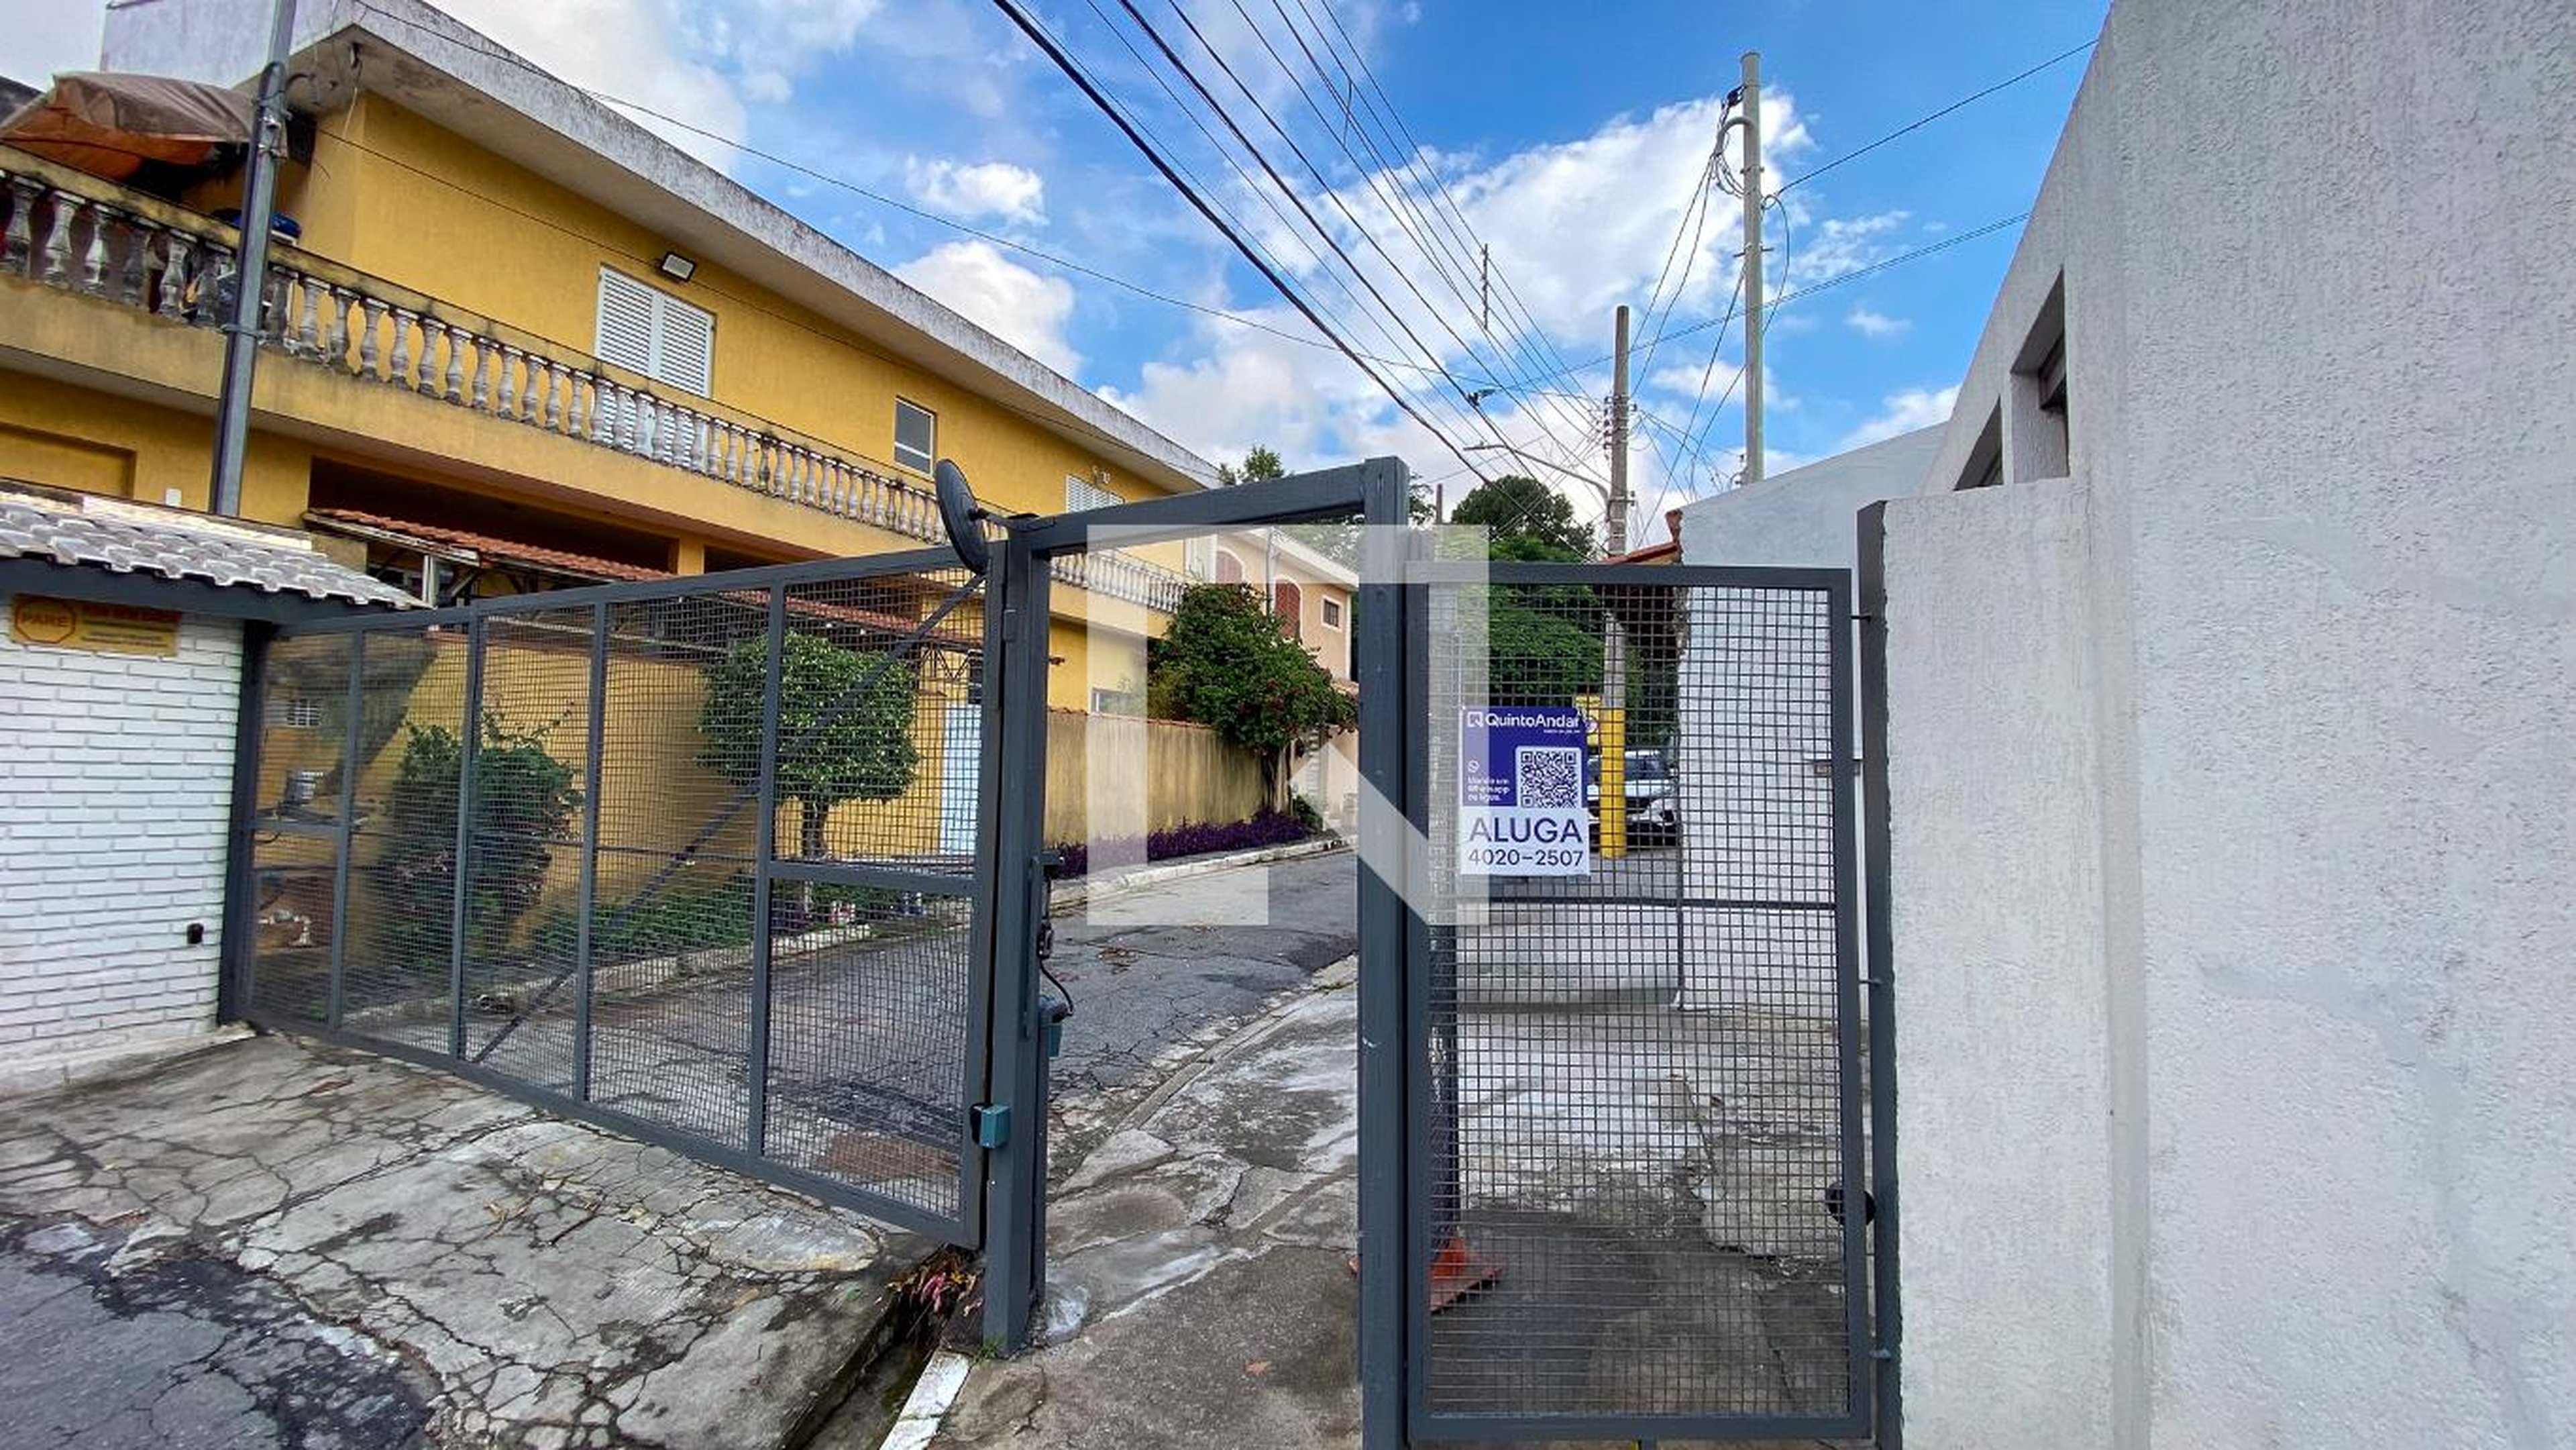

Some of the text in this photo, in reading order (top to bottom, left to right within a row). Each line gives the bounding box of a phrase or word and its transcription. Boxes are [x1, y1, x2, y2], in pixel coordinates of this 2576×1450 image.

[21, 612, 68, 627] PARE
[1485, 713, 1580, 727] QuintoAndar
[1469, 817, 1583, 843] ALUGA
[1468, 849, 1583, 866] 4020-2507
